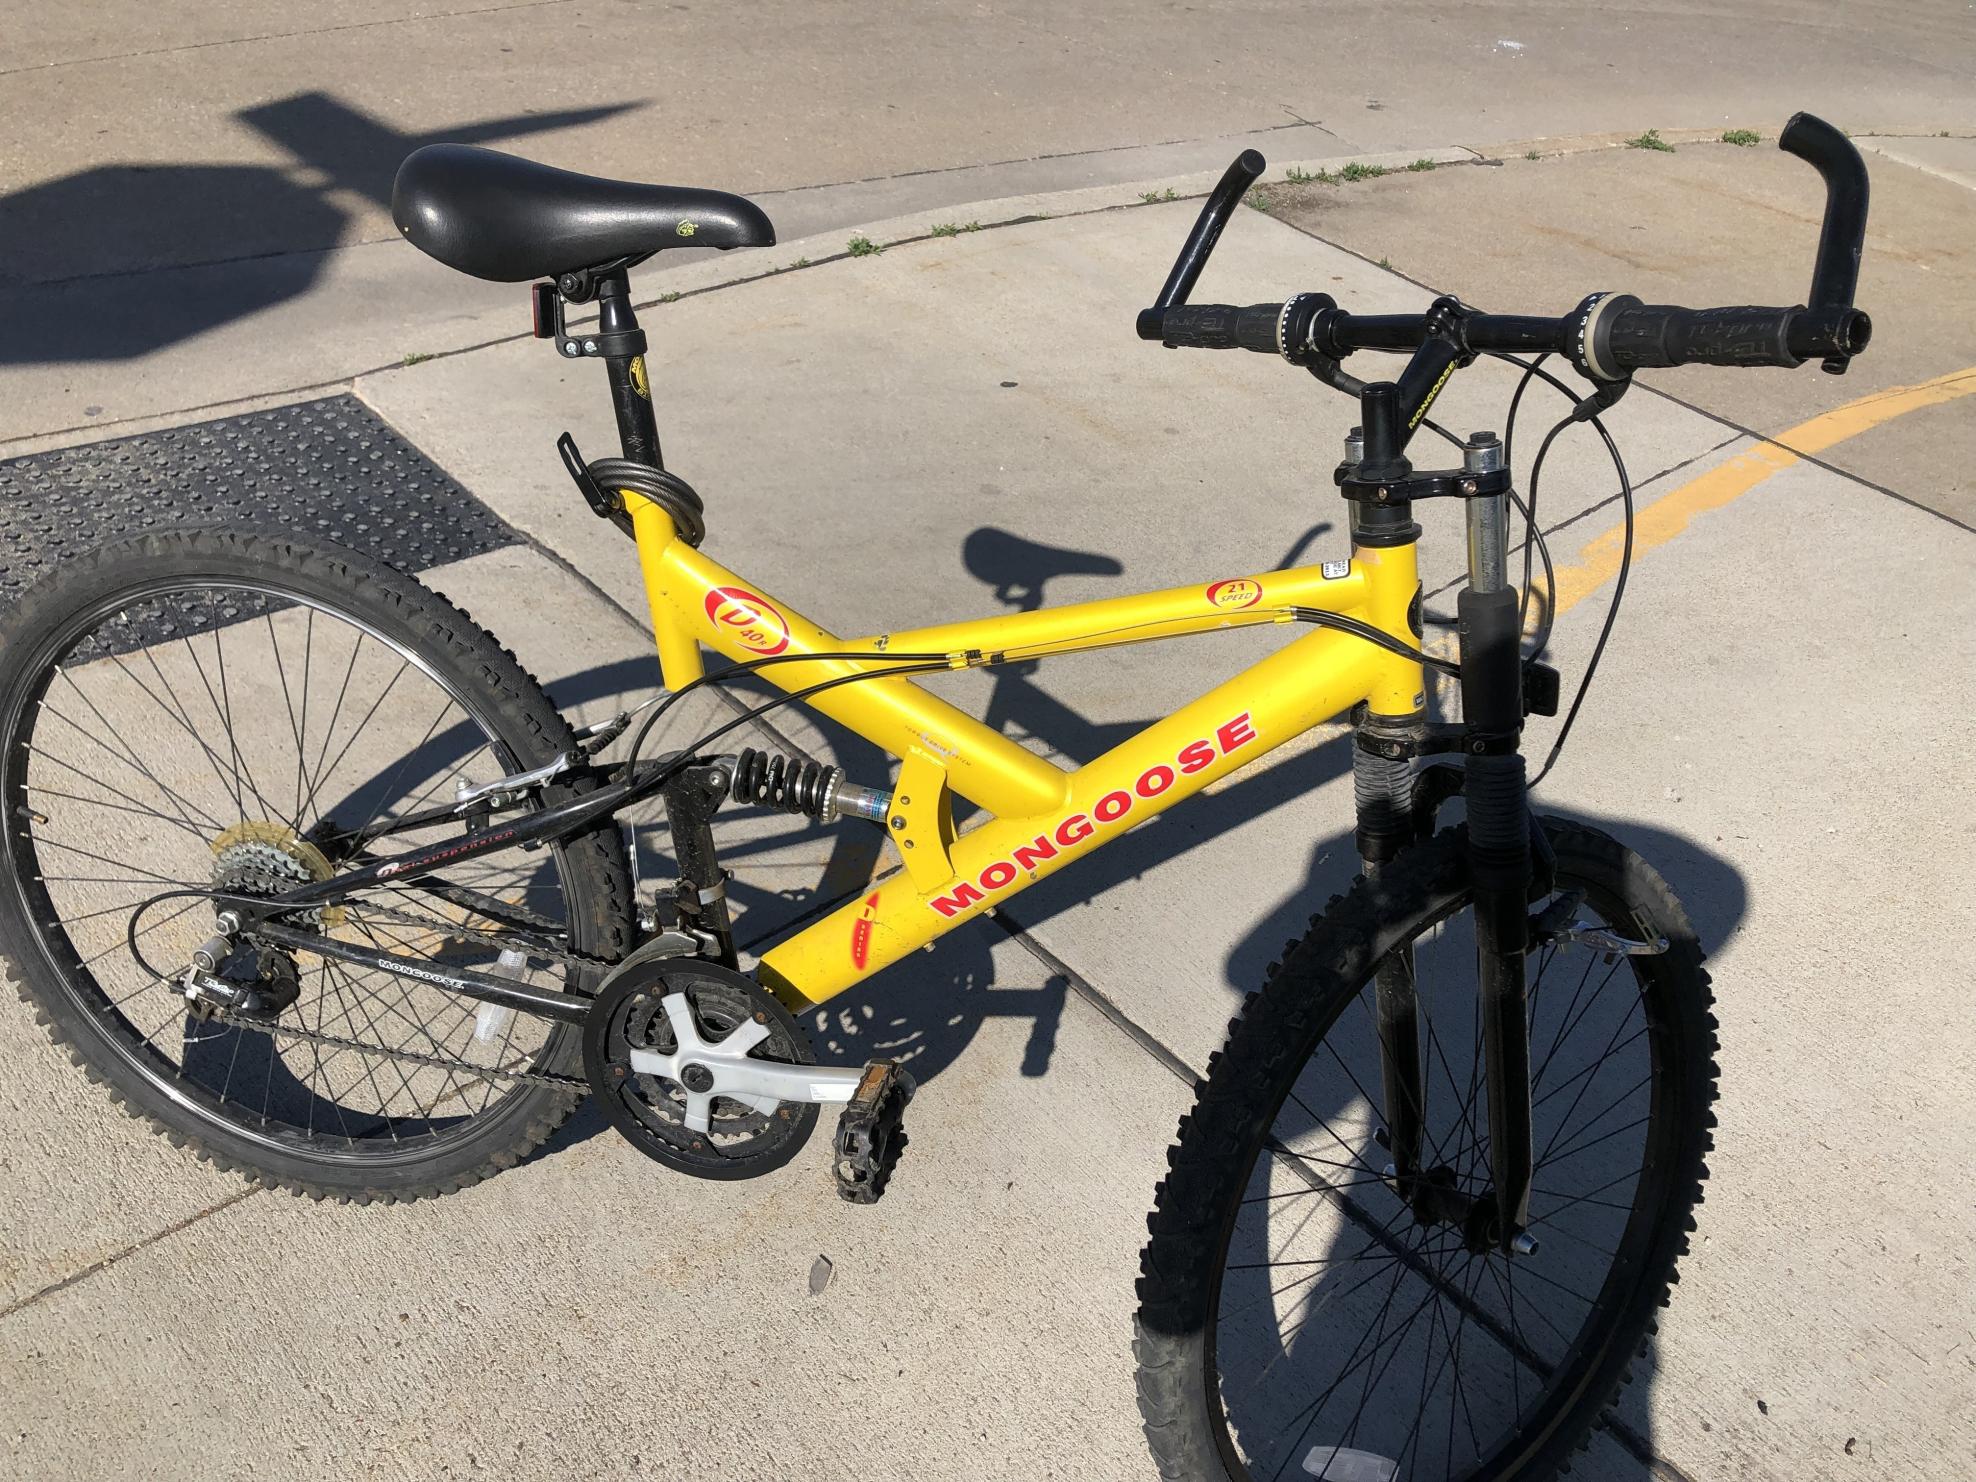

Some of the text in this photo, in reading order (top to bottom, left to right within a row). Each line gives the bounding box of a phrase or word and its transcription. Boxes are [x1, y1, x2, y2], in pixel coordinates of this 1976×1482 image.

[1586, 303, 1595, 312] 2
[1581, 316, 1589, 326] 3
[1578, 329, 1585, 339] 4
[1578, 344, 1584, 354] 5
[1581, 358, 1588, 367] 6
[1408, 360, 1455, 430] MONGOOSE
[1227, 582, 1245, 593] 21
[1220, 592, 1253, 603] SPEED
[929, 712, 1257, 919] MONGOOSE
[378, 959, 464, 989] MONGOOSE
